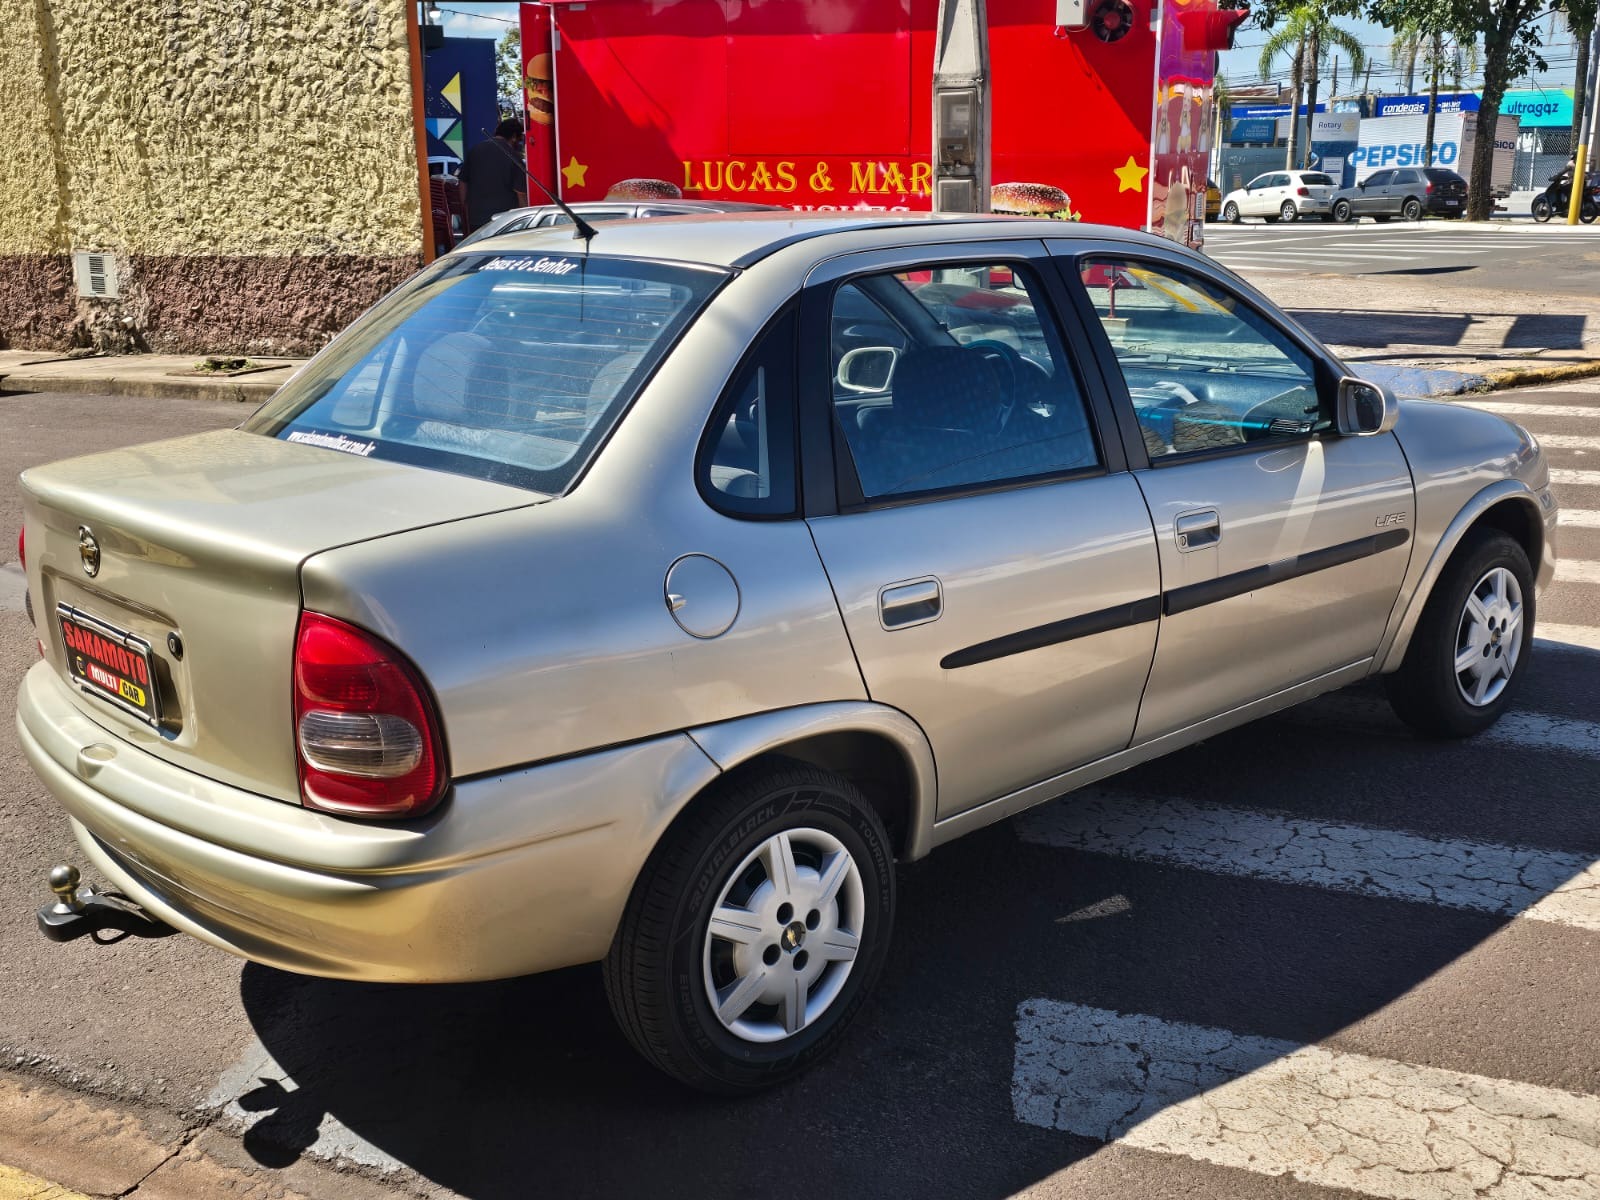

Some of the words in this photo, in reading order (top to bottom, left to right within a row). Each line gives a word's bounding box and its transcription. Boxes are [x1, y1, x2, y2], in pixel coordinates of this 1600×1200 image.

[1507, 101, 1559, 117] ultragaz
[1318, 121, 1342, 129] Rotary
[1351, 141, 1457, 167] PEPSICO
[682, 160, 798, 192] LUCAS
[809, 161, 835, 192] &
[849, 161, 932, 195] MAR
[1375, 511, 1406, 527] LIFE
[62, 620, 148, 686] SAKAMOTO
[90, 664, 118, 691] MULTI
[121, 681, 141, 703] CAR
